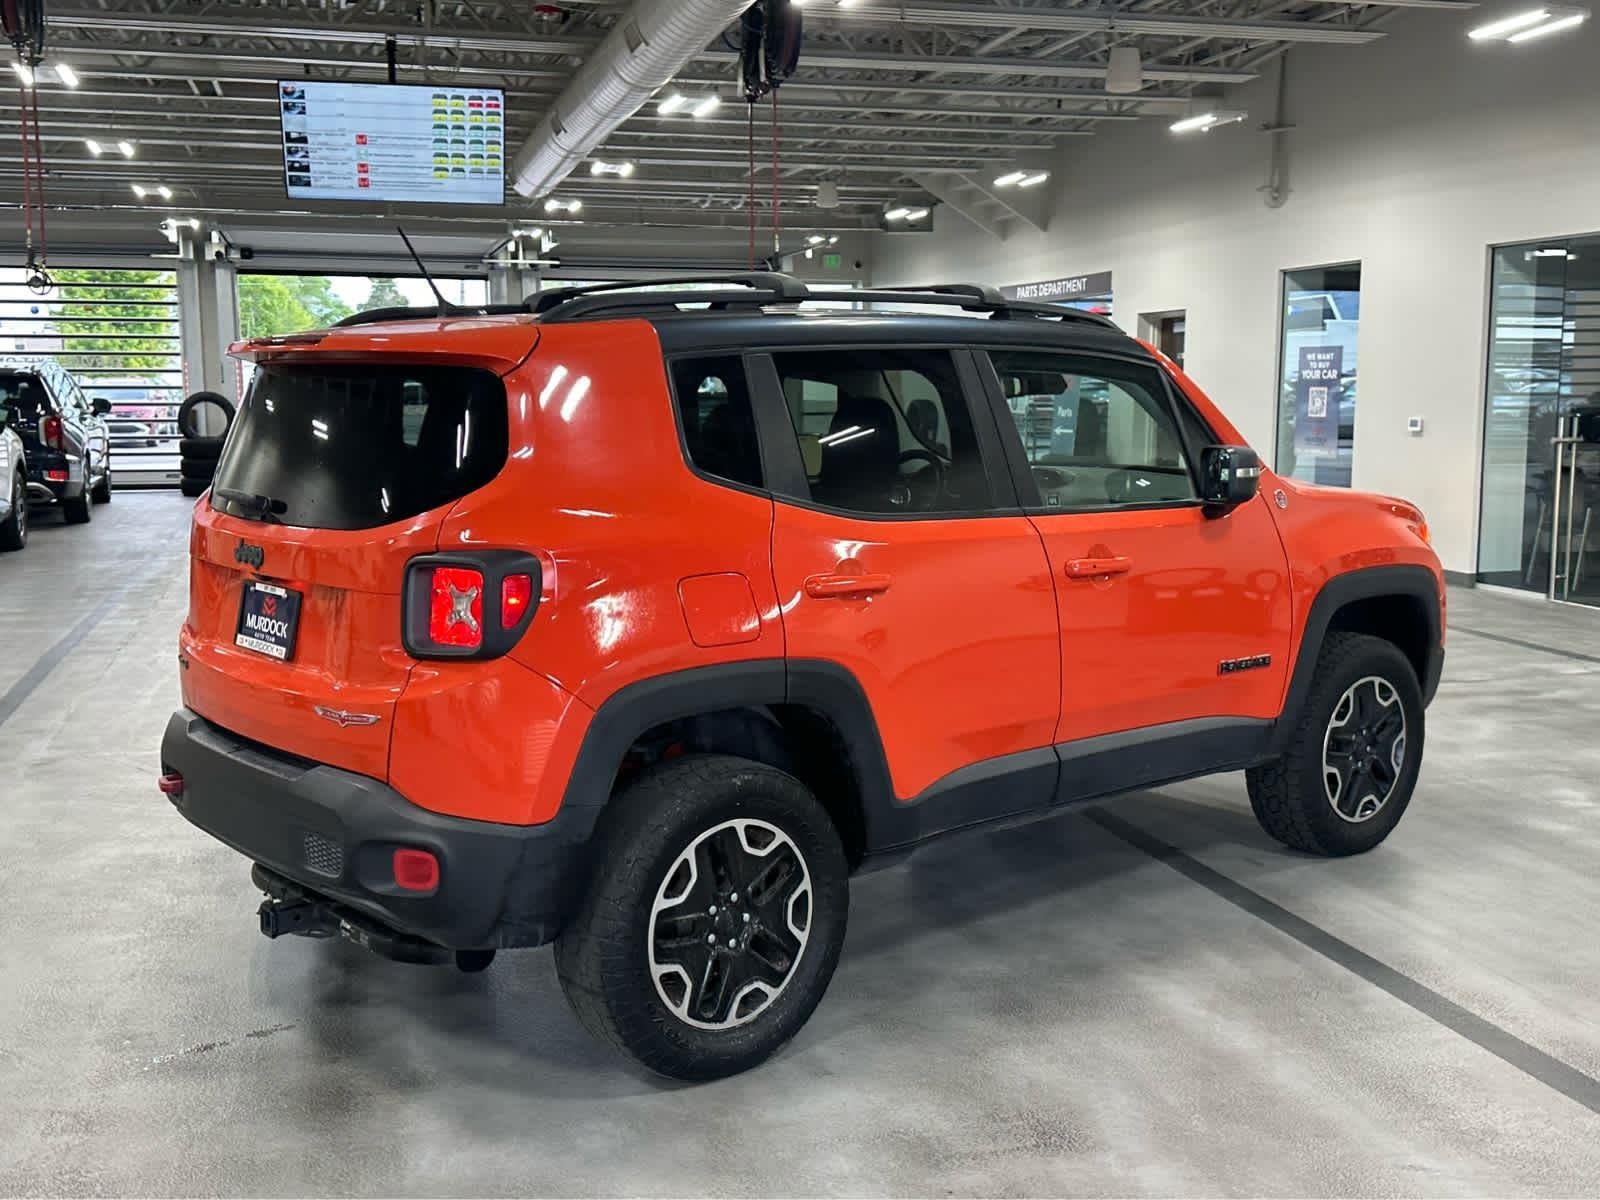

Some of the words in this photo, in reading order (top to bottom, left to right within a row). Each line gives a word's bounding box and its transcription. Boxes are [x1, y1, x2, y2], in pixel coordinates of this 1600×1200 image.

[1016, 285, 1038, 299] PARTS
[1039, 278, 1087, 295] DEPARTMENT
[1317, 352, 1335, 360] WANT
[1302, 369, 1321, 380] YOUR
[1321, 369, 1338, 379] CAR
[246, 612, 289, 639] MURDOCK
